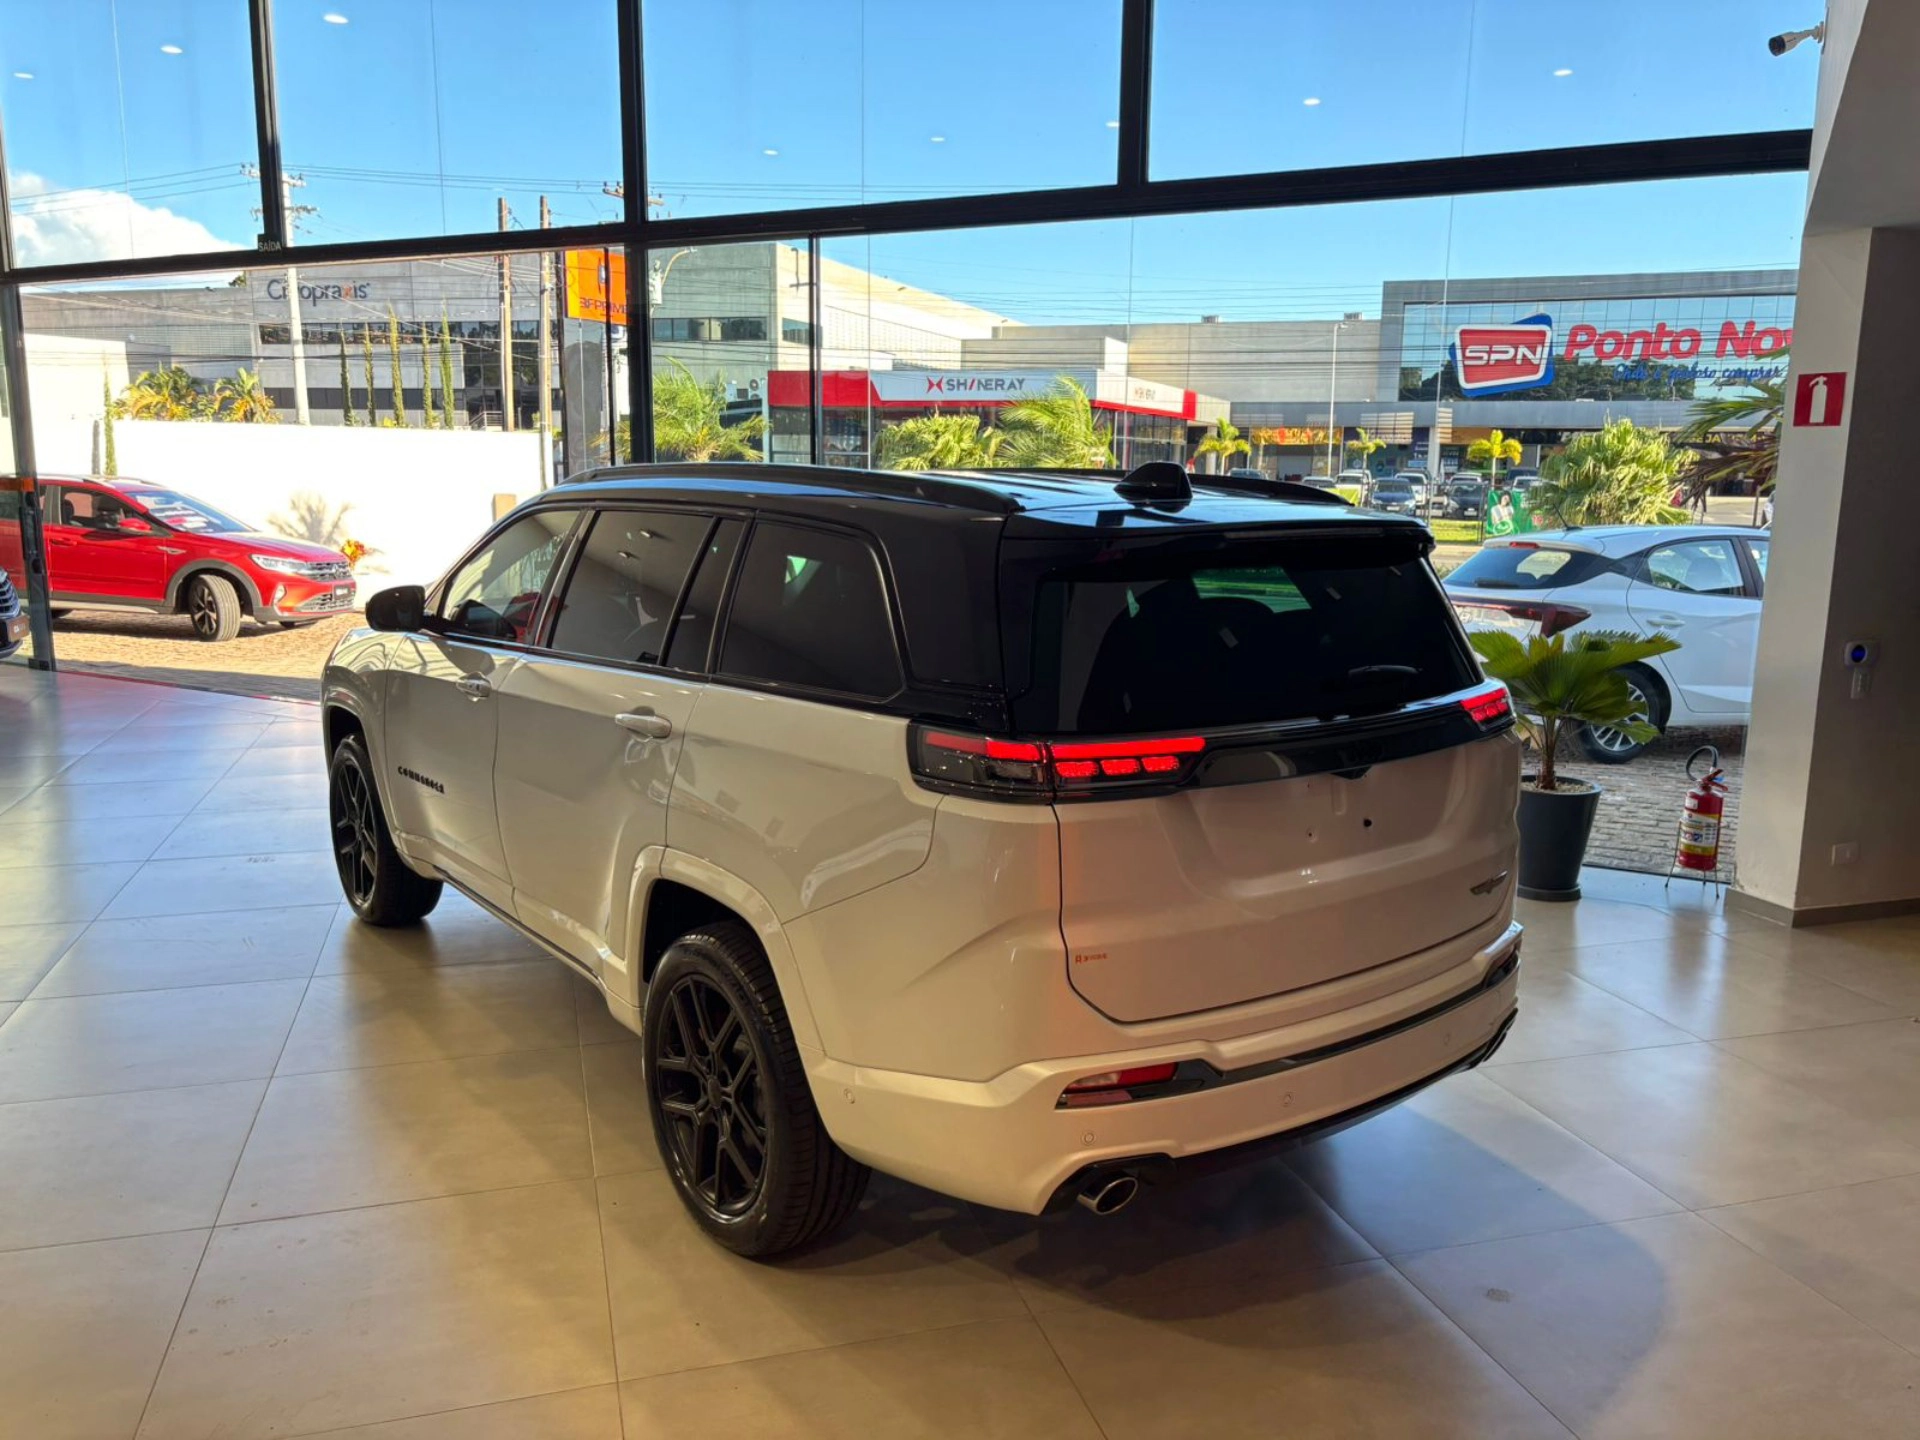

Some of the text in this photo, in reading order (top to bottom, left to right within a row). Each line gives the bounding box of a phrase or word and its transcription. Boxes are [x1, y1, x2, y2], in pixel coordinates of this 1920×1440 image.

[258, 241, 281, 252] SAÍDA
[267, 279, 368, 307] Cropraxis
[1564, 322, 1703, 362] Ponto
[1464, 345, 1544, 366] SPN
[946, 378, 1025, 392] SHINERAY
